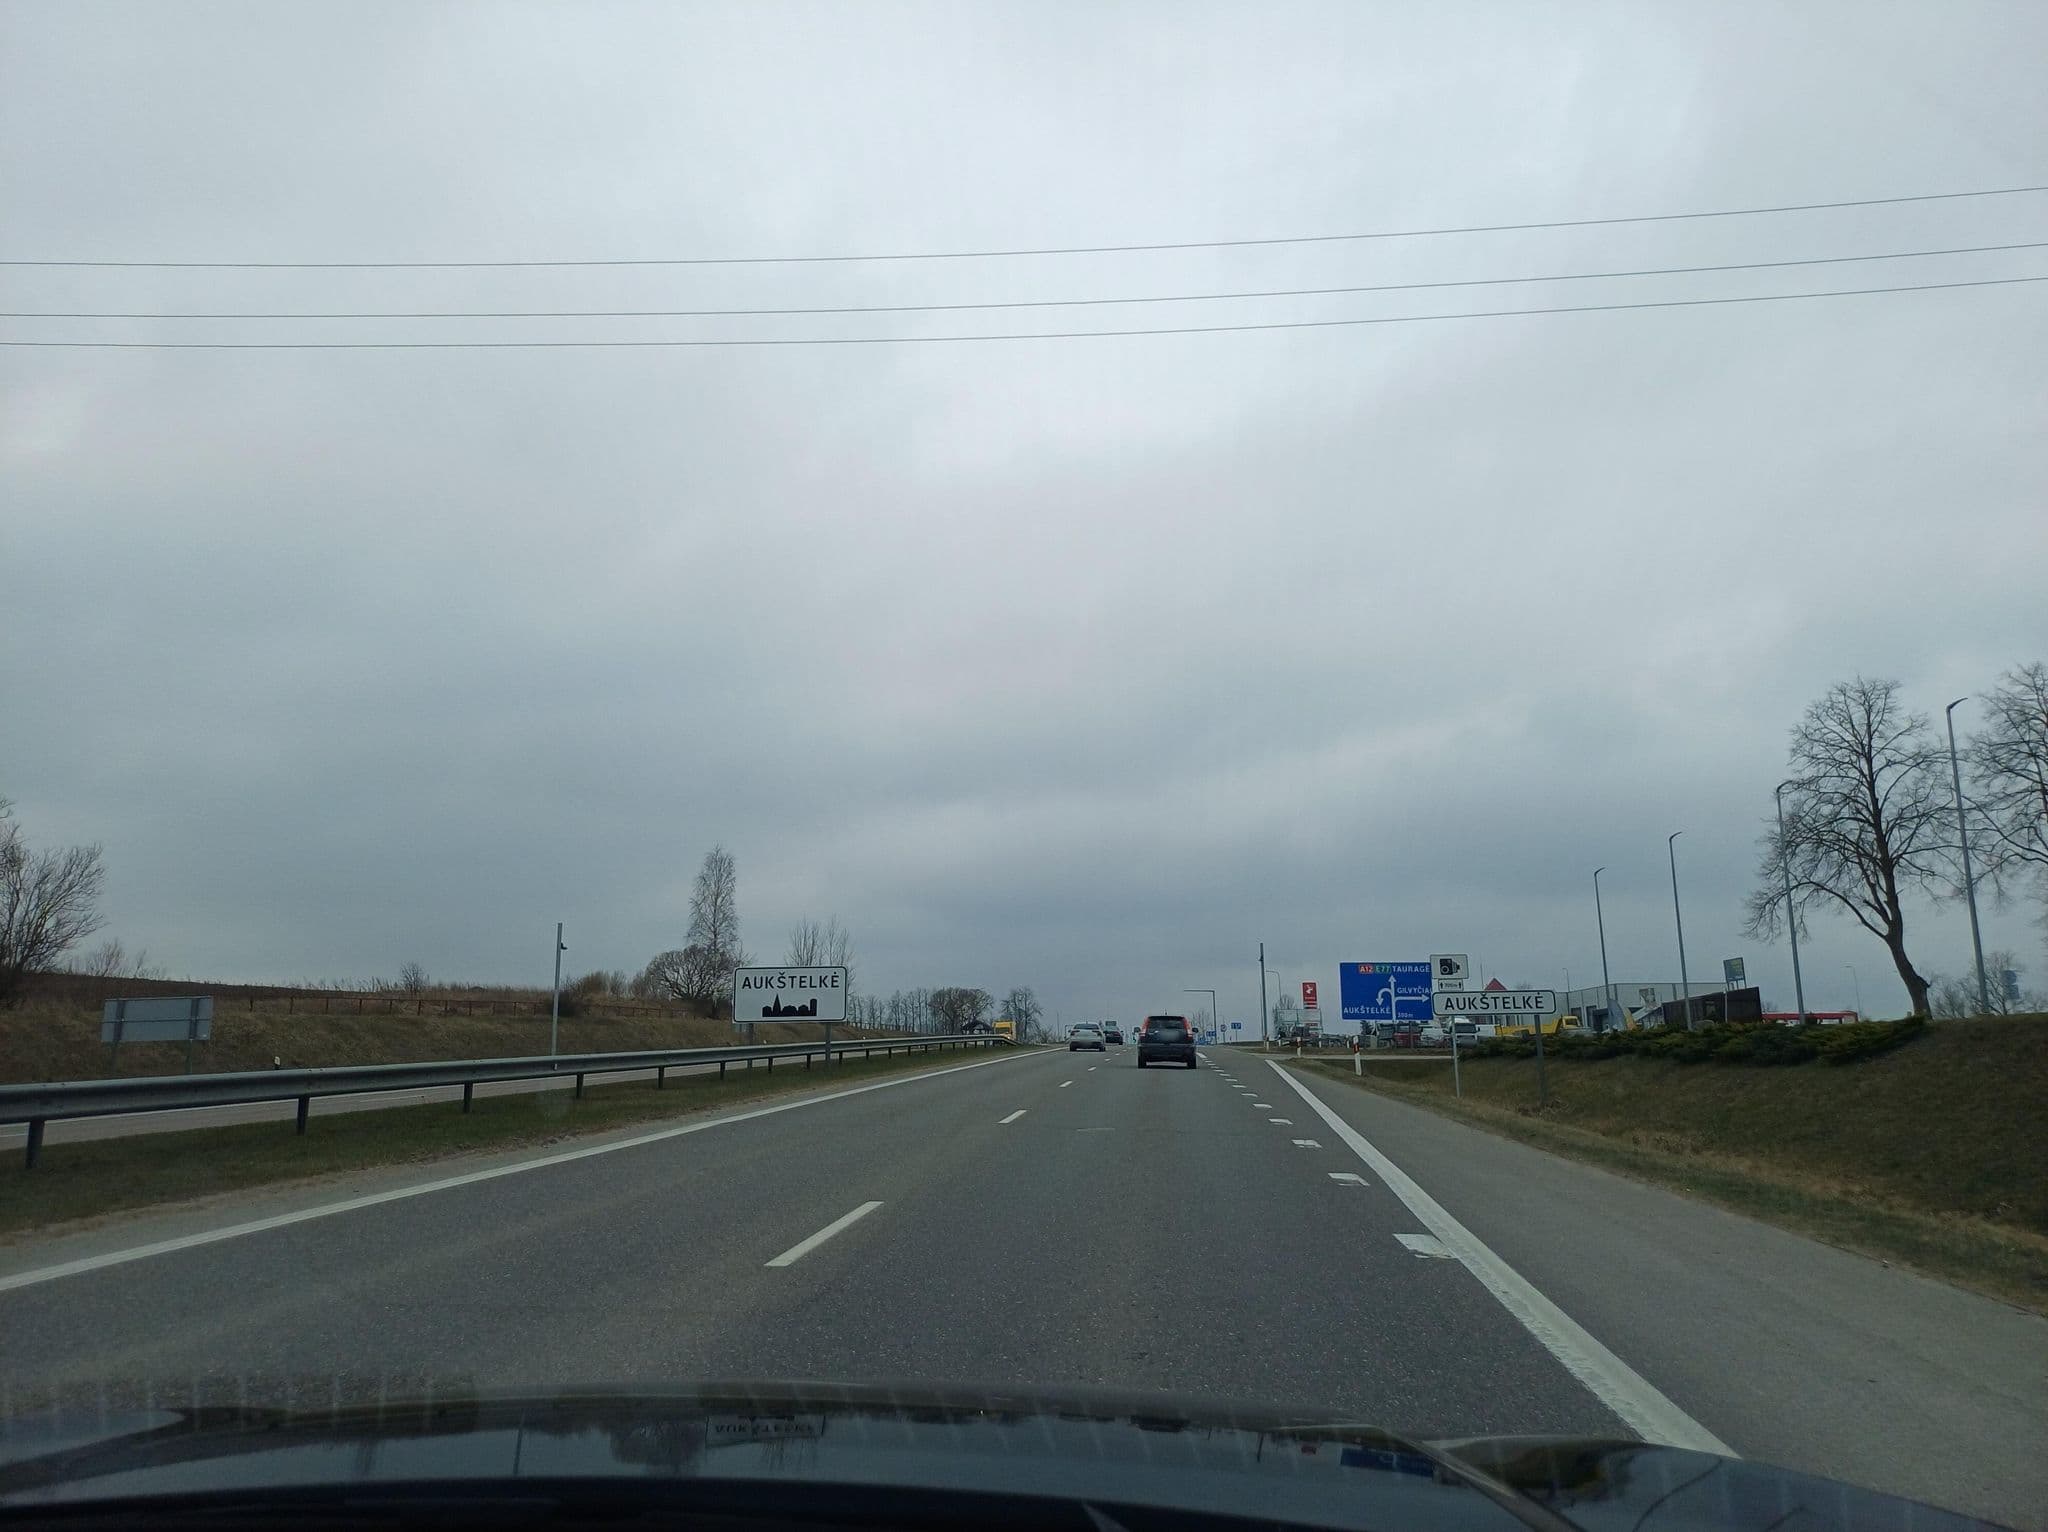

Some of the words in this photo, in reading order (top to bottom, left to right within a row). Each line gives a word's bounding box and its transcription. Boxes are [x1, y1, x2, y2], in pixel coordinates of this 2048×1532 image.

[1360, 965, 1373, 973] A12
[1375, 965, 1391, 974] E77
[1392, 964, 1430, 973] TAURAGĖ
[741, 971, 840, 989] AUKŠTELKĖ
[1444, 992, 1545, 1011] AUKŠTELKĖ
[1343, 1005, 1391, 1014] AUKŠTELKĖ
